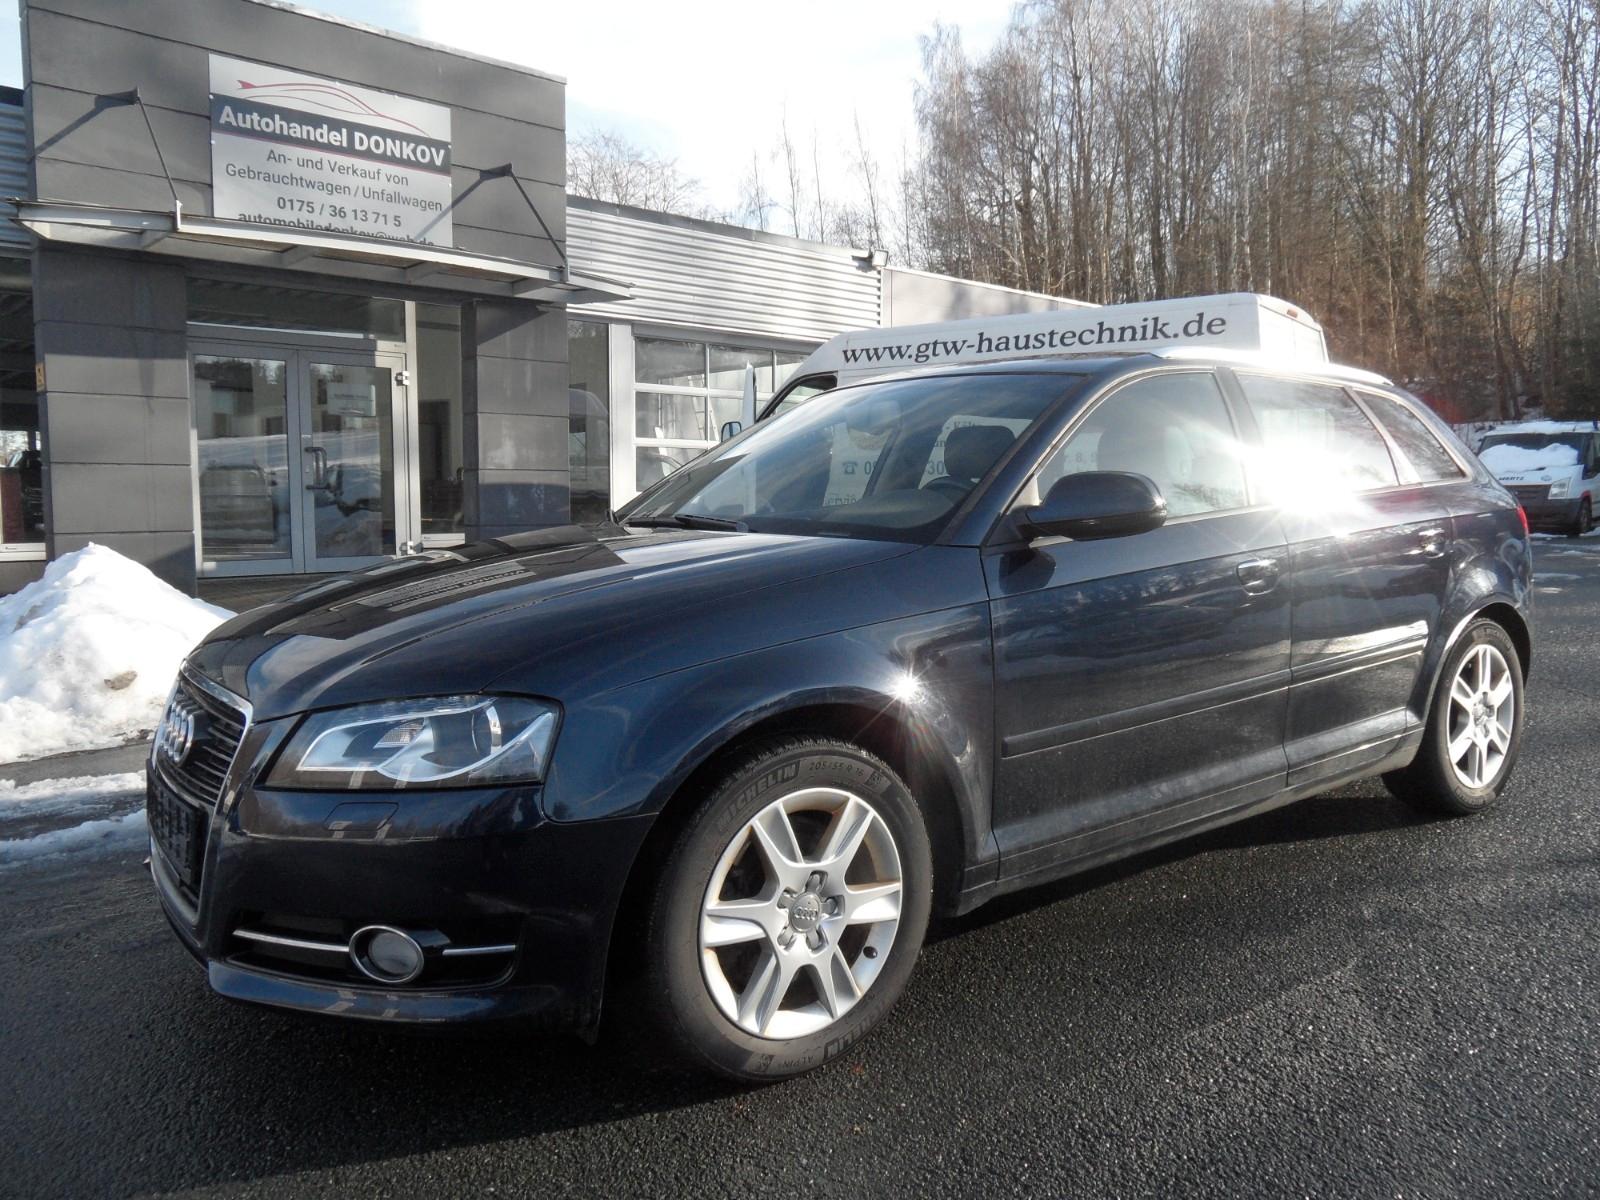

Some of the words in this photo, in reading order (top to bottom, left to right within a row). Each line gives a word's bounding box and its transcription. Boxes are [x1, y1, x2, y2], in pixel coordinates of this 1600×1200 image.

[219, 105, 347, 147] Autohandel
[354, 132, 445, 166] DONKOV
[225, 163, 351, 197] Gebrauchtwagen
[361, 187, 442, 213] Unfallwagen
[266, 149, 292, 164] An-
[297, 156, 323, 171] und
[328, 160, 381, 182] Verkauf
[385, 173, 409, 186] von
[277, 196, 315, 214] 0175
[329, 205, 347, 219] 36
[351, 208, 368, 223] 13
[372, 212, 388, 226] 71
[393, 215, 402, 228] 5
[842, 312, 1227, 363] www.gtw-haustechnik.de
